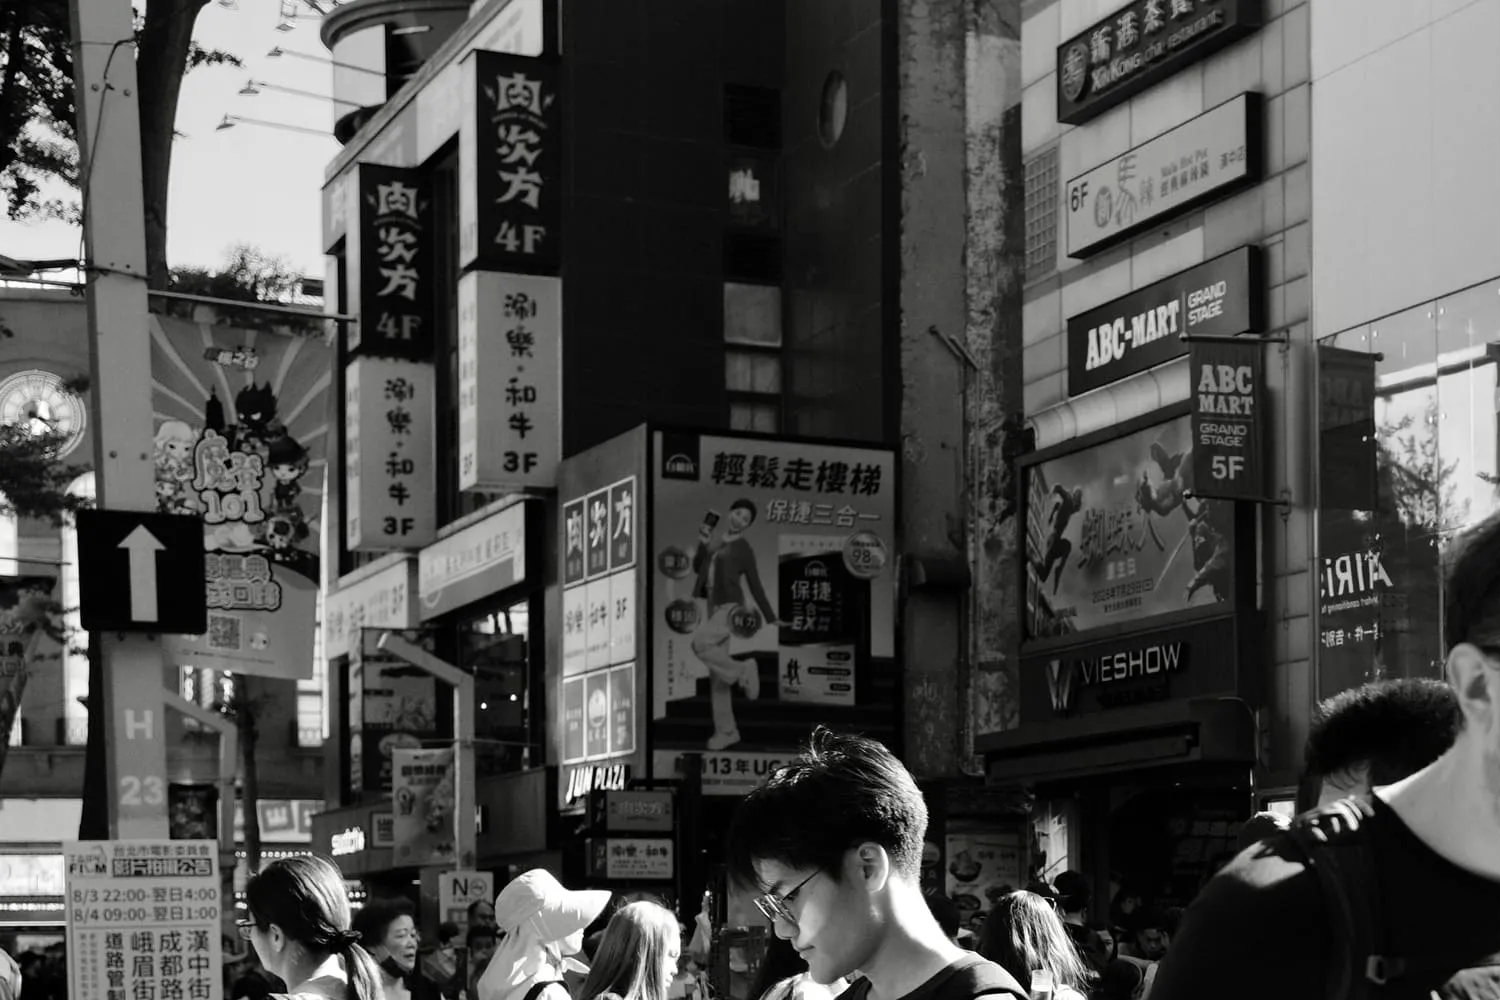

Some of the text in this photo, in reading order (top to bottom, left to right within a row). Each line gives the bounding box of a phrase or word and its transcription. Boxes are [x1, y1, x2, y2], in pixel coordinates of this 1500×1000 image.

[1070, 181, 1089, 213] 6F
[492, 218, 548, 254] 4F
[1187, 281, 1227, 309] GRAND
[375, 310, 423, 341] 4F
[1188, 300, 1223, 327] STAGE
[1085, 299, 1180, 371] ABC-MART
[1197, 364, 1253, 394] ABC
[1198, 394, 1254, 416] MART
[1199, 422, 1248, 437] GRAND
[1199, 434, 1245, 448] STAGE
[502, 449, 538, 475] 3F
[711, 451, 882, 495] 輕鬆走樓梯
[1211, 455, 1245, 481] 5F
[381, 515, 416, 537] 3F
[765, 498, 881, 528] 保捷三合一
[851, 549, 870, 564] 98
[790, 579, 833, 601] 保捷
[790, 602, 833, 616] 三合一
[791, 615, 817, 631] EX
[1080, 641, 1182, 685] VIESHOW
[123, 707, 154, 740] H
[120, 775, 164, 806] 23
[594, 764, 626, 791] PLAZA
[73, 889, 99, 904] 8/3
[73, 907, 99, 924] 8/4
